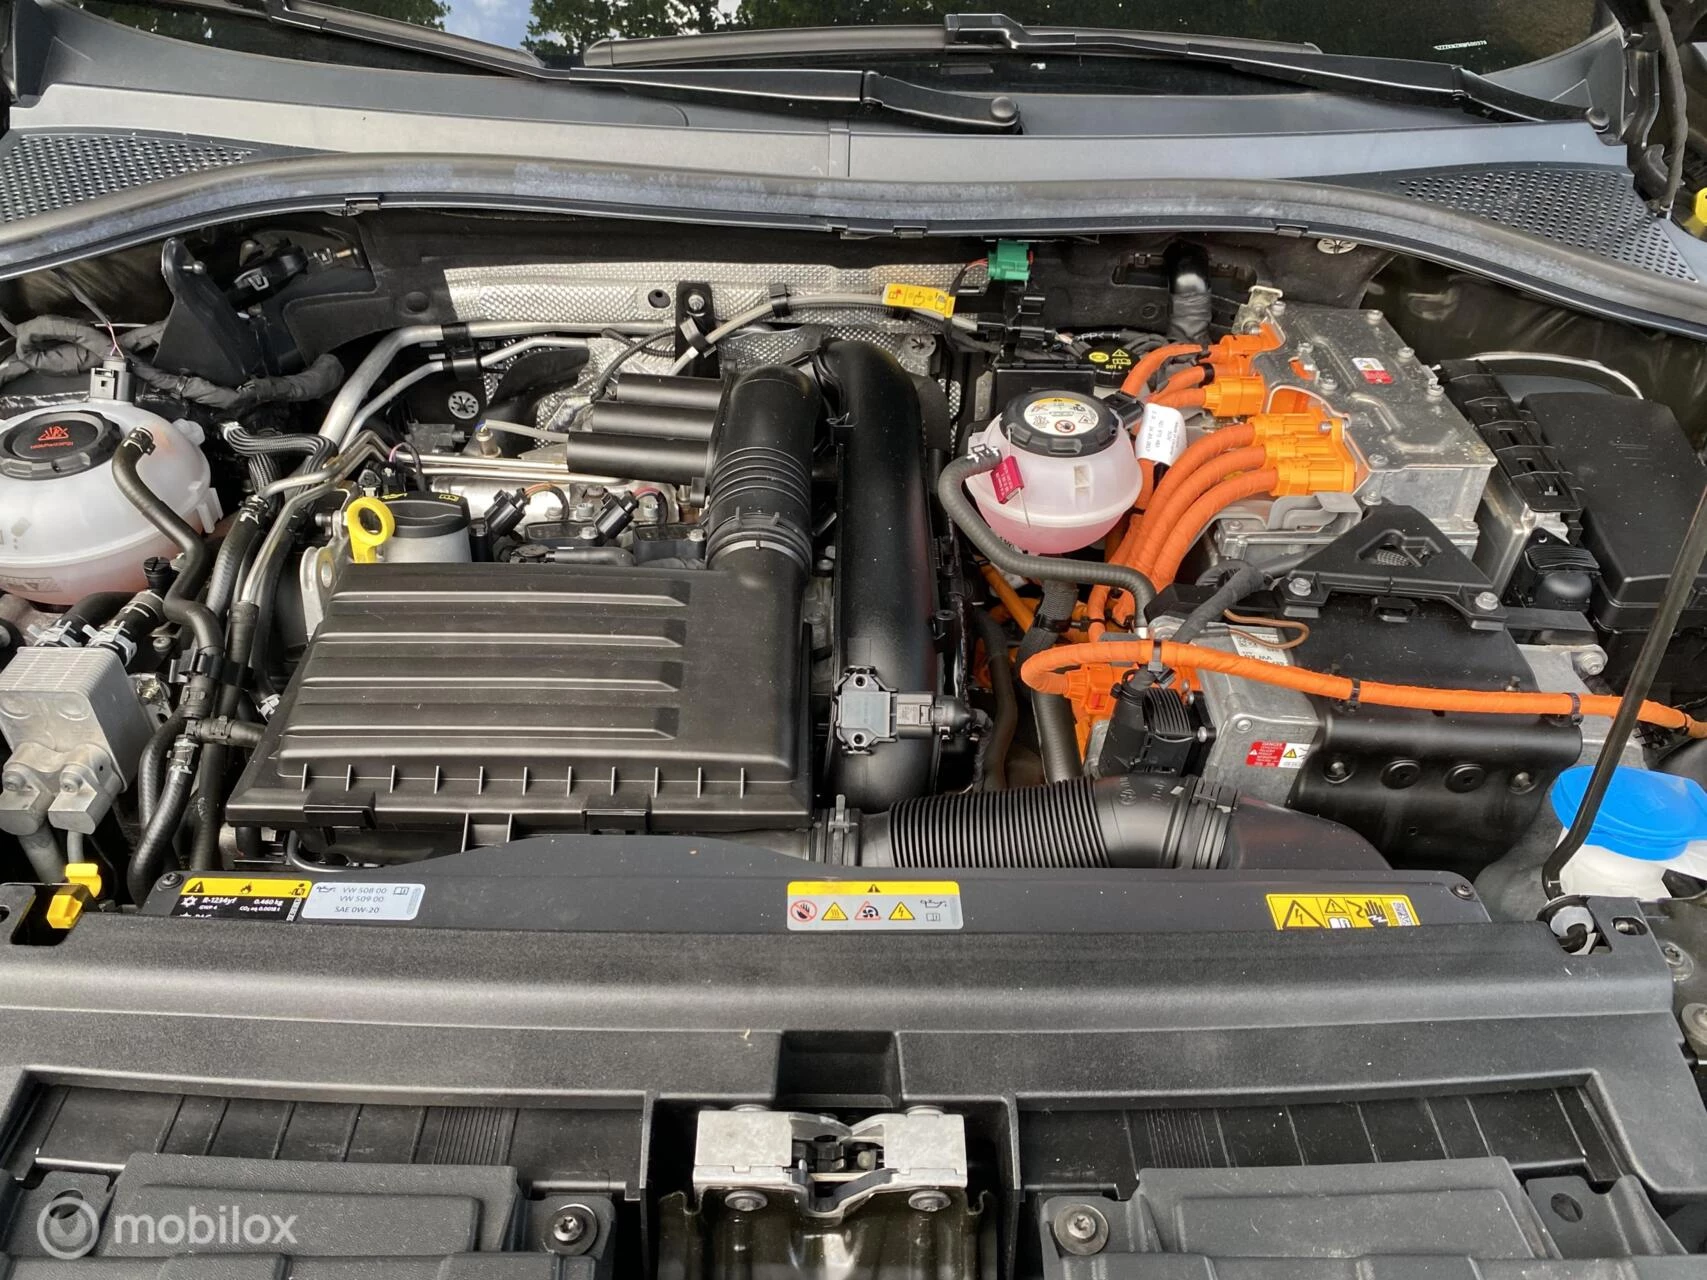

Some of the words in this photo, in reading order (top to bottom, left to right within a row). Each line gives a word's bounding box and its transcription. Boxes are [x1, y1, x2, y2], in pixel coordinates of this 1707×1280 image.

[202, 897, 237, 905] R-1234yf
[355, 895, 372, 903] 509
[373, 895, 385, 903] 00
[335, 905, 350, 913] SAE
